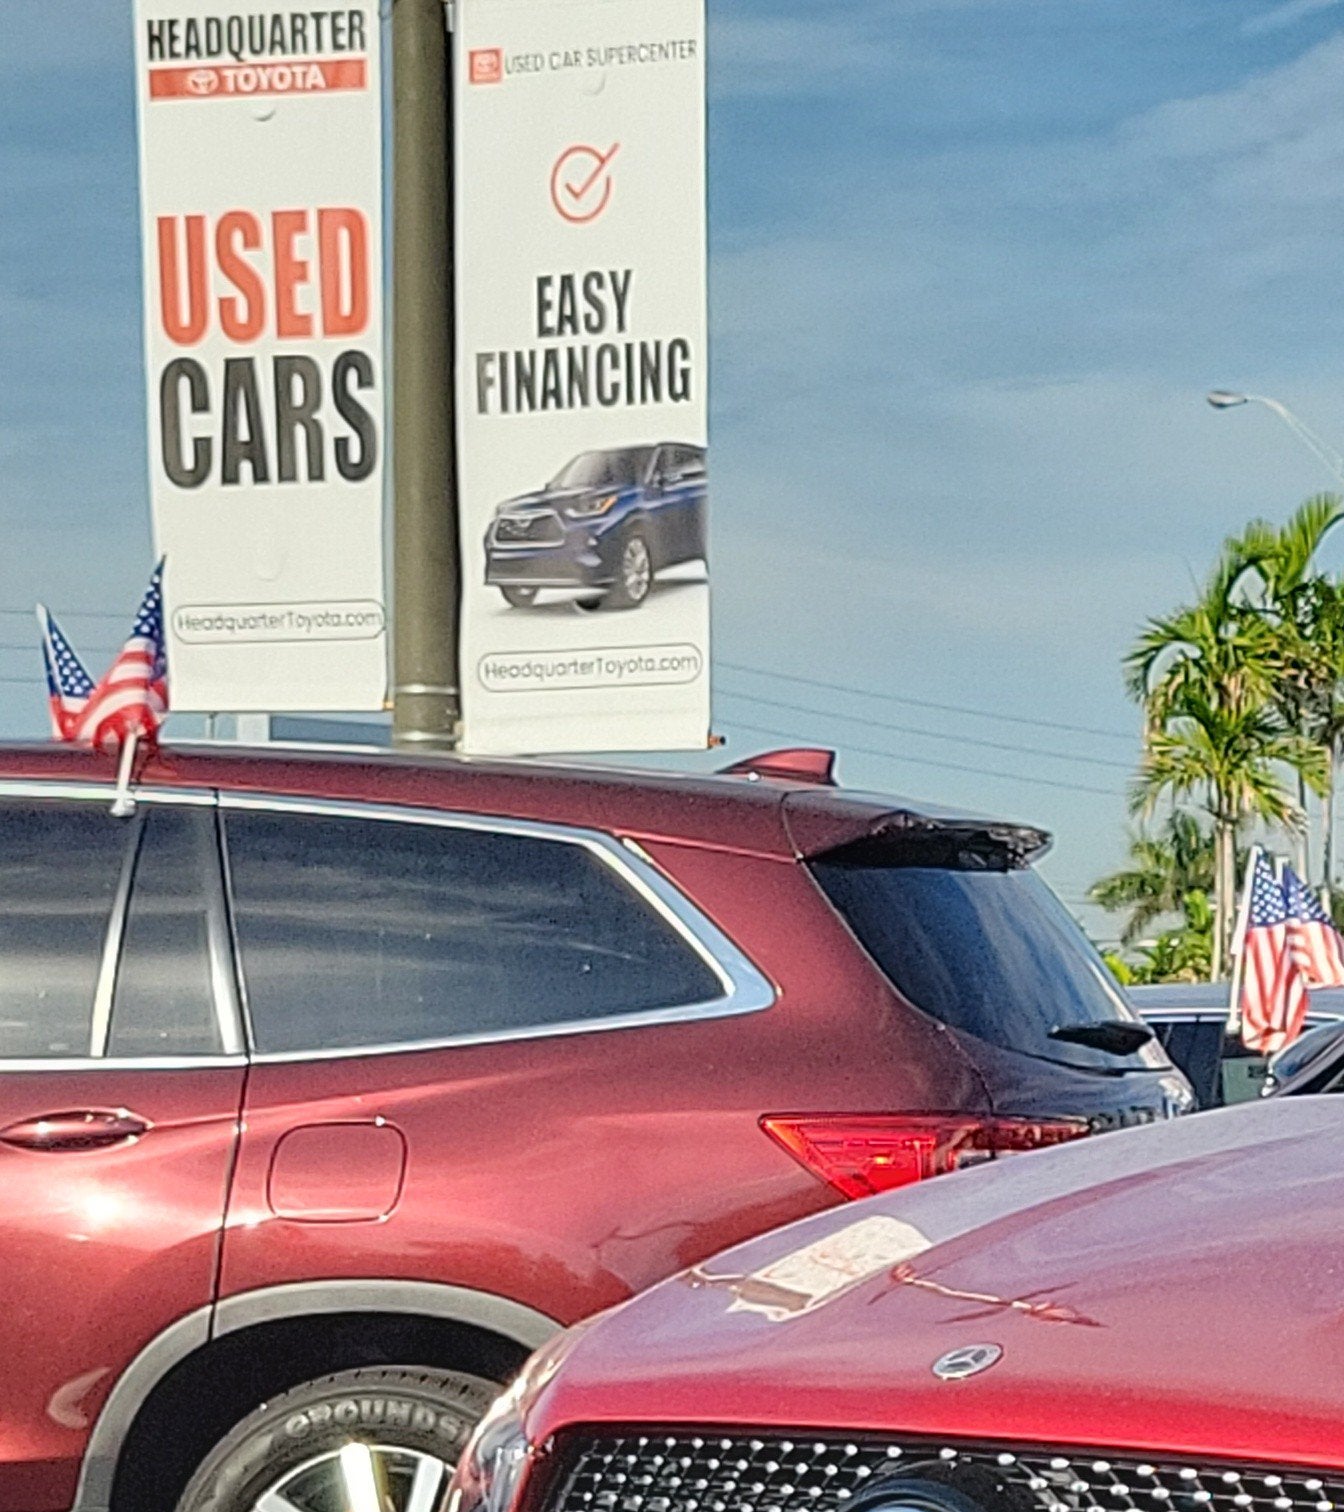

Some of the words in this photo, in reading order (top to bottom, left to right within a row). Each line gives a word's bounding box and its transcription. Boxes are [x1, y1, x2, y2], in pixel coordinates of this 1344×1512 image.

[146, 9, 367, 62] HEADQUARTER
[506, 53, 544, 75] USED
[550, 50, 580, 70] CAR
[587, 39, 698, 67] SUPERCENTER
[222, 61, 326, 93] TOYOTA
[156, 206, 370, 346] USED
[535, 269, 633, 338] EASY
[475, 337, 691, 414] FINANCING
[159, 350, 377, 489] CARS
[176, 609, 383, 634] HeadquarterToyota.com
[485, 650, 697, 684] HeadquarterToyota.com
